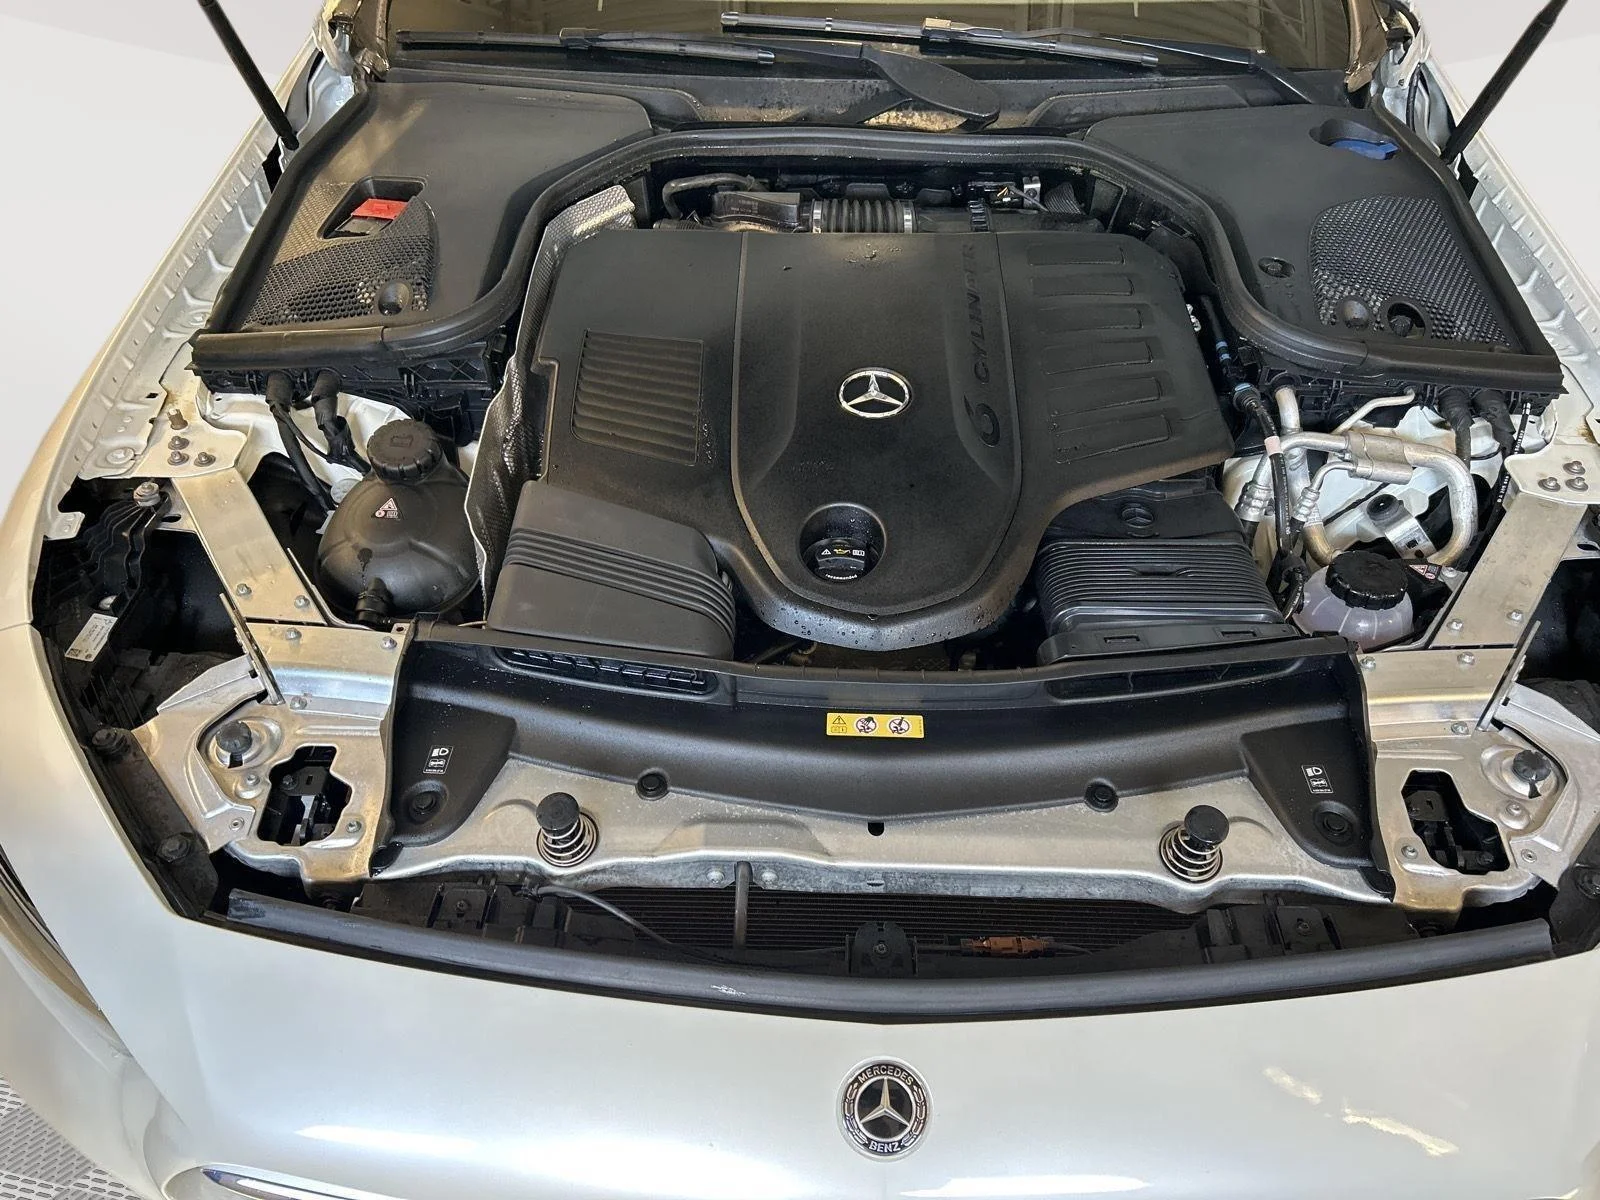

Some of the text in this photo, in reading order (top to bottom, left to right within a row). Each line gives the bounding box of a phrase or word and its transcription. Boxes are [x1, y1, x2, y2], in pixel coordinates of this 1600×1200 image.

[962, 244, 990, 384] CYLINDER
[857, 1065, 913, 1086] MERCEDES
[868, 1140, 901, 1153] BENZ
